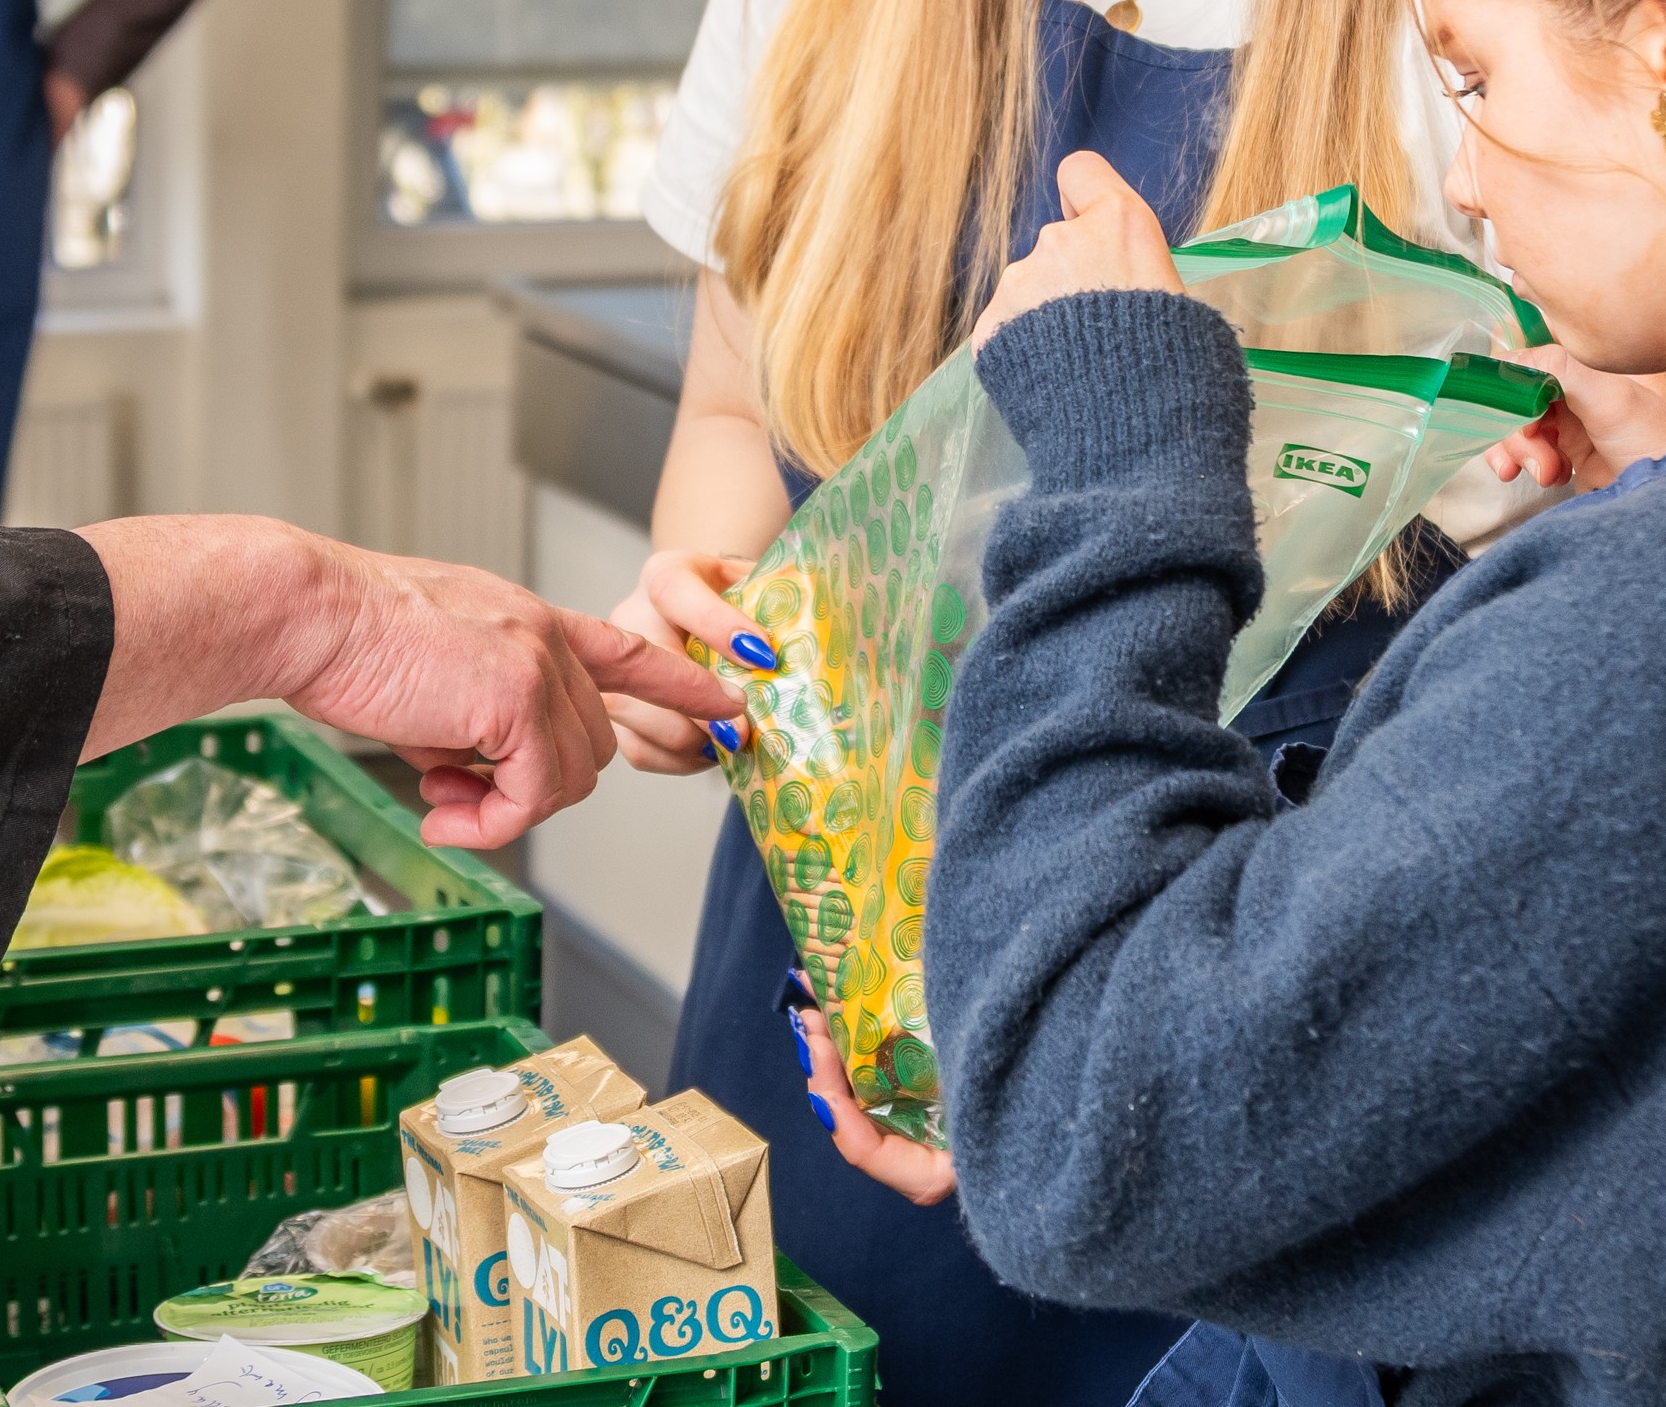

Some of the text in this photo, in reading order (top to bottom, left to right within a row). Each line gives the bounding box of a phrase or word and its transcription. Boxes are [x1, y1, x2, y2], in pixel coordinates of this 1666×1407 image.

[1282, 453, 1355, 482] IKEA
[400, 1129, 417, 1152] THE
[456, 1139, 502, 1149] SHAKE
[453, 1146, 483, 1158] ME!
[504, 1184, 520, 1208] THE
[422, 1237, 461, 1345] LY!
[585, 1284, 774, 1368] Q&Q
[322, 1334, 391, 1355] GEFERMENTEERD
[484, 1344, 514, 1356] capsul
[485, 1356, 514, 1367] wouldn
